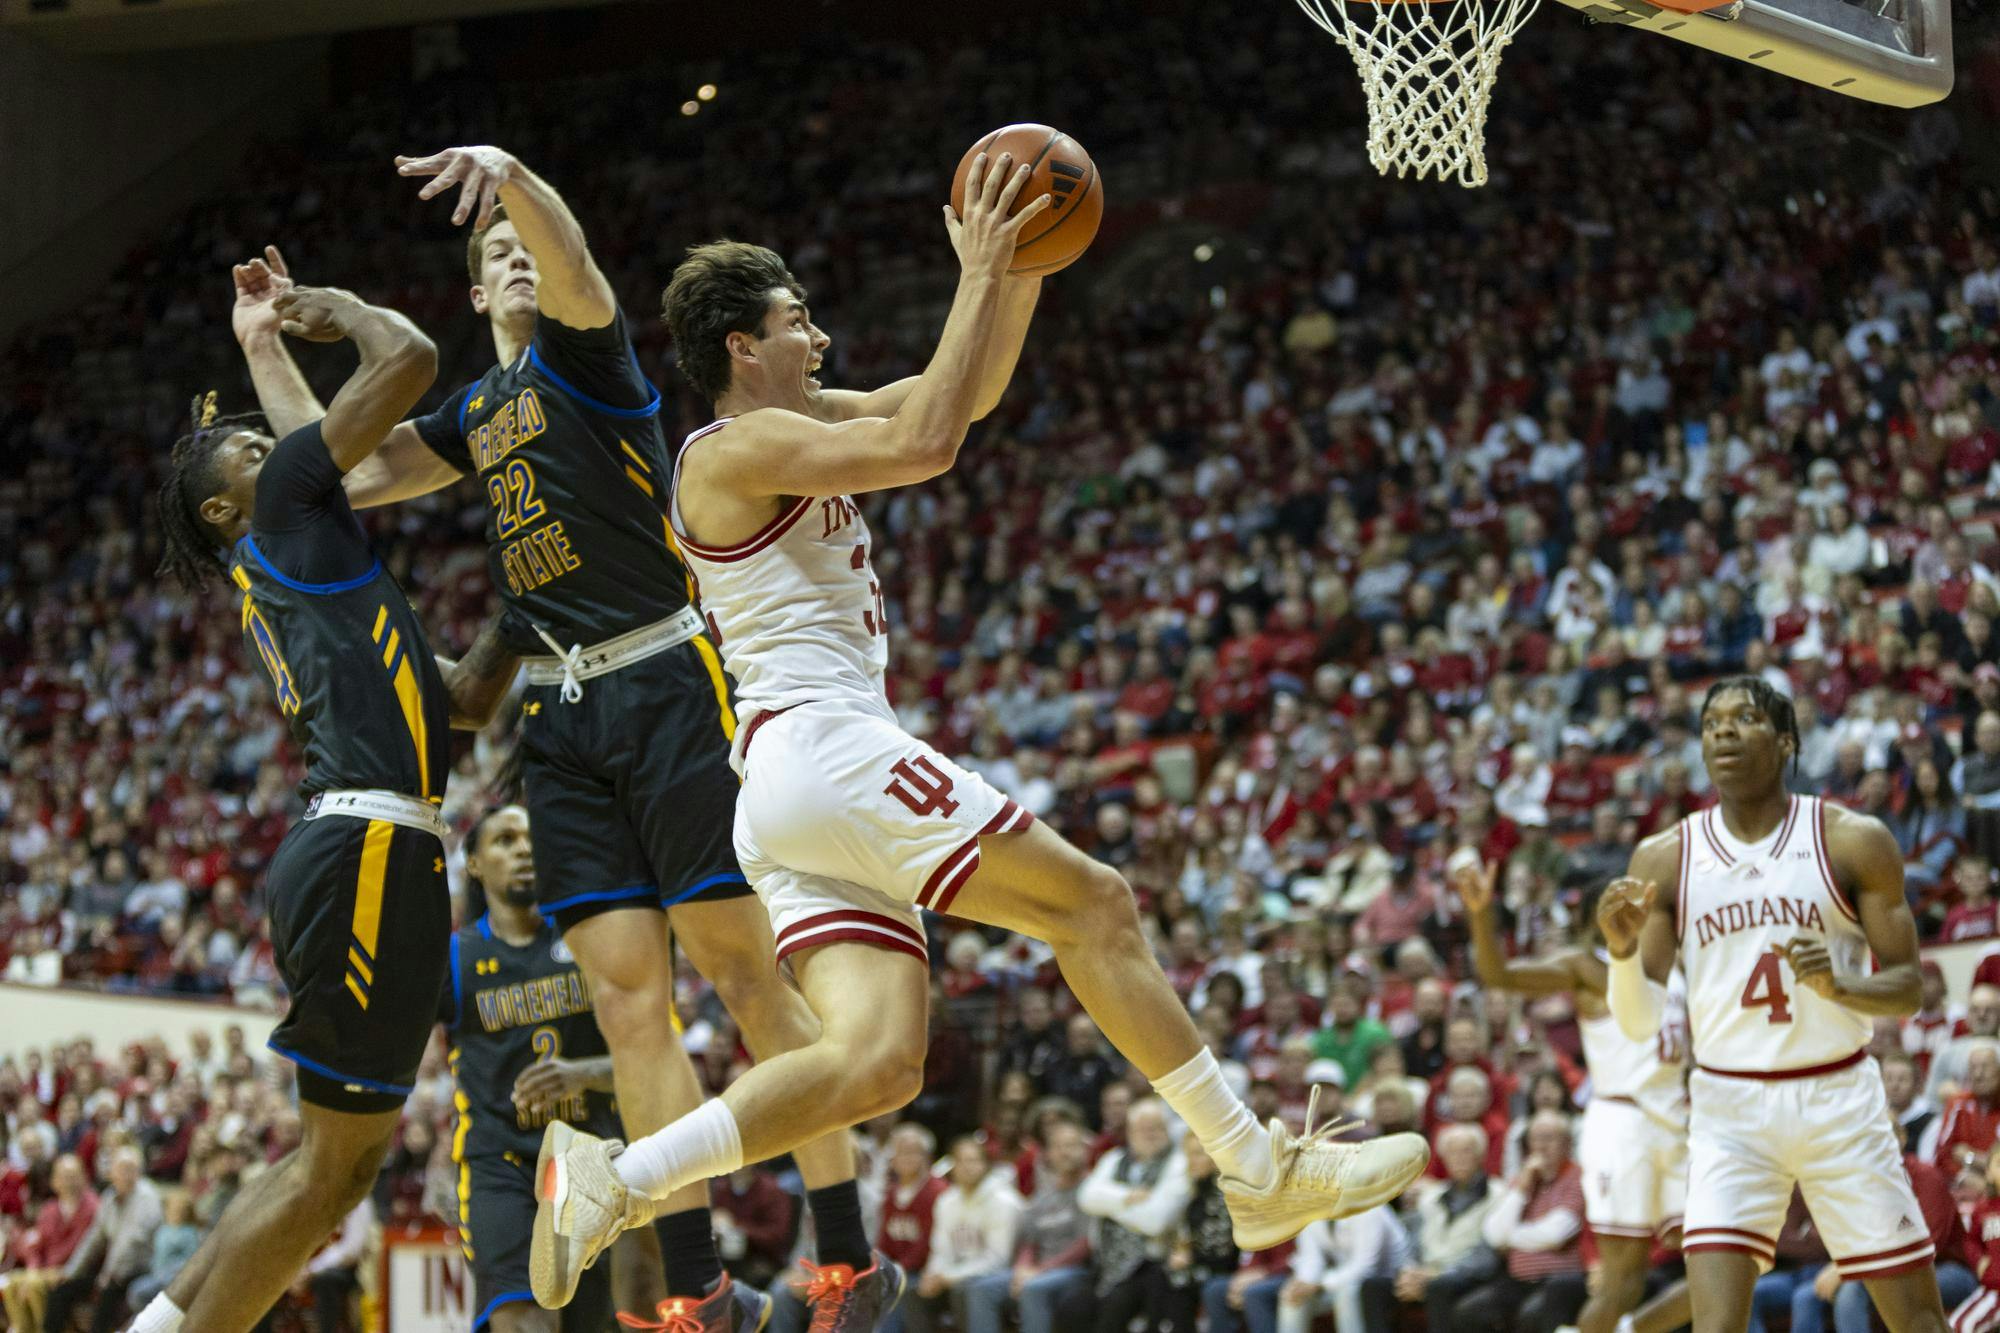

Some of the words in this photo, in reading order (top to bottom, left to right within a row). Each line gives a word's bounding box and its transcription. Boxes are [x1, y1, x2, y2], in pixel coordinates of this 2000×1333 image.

[487, 458, 547, 540] 22
[501, 520, 582, 597] STATE
[1695, 896, 1826, 949] INDIANA
[1741, 951, 1792, 1024] 4
